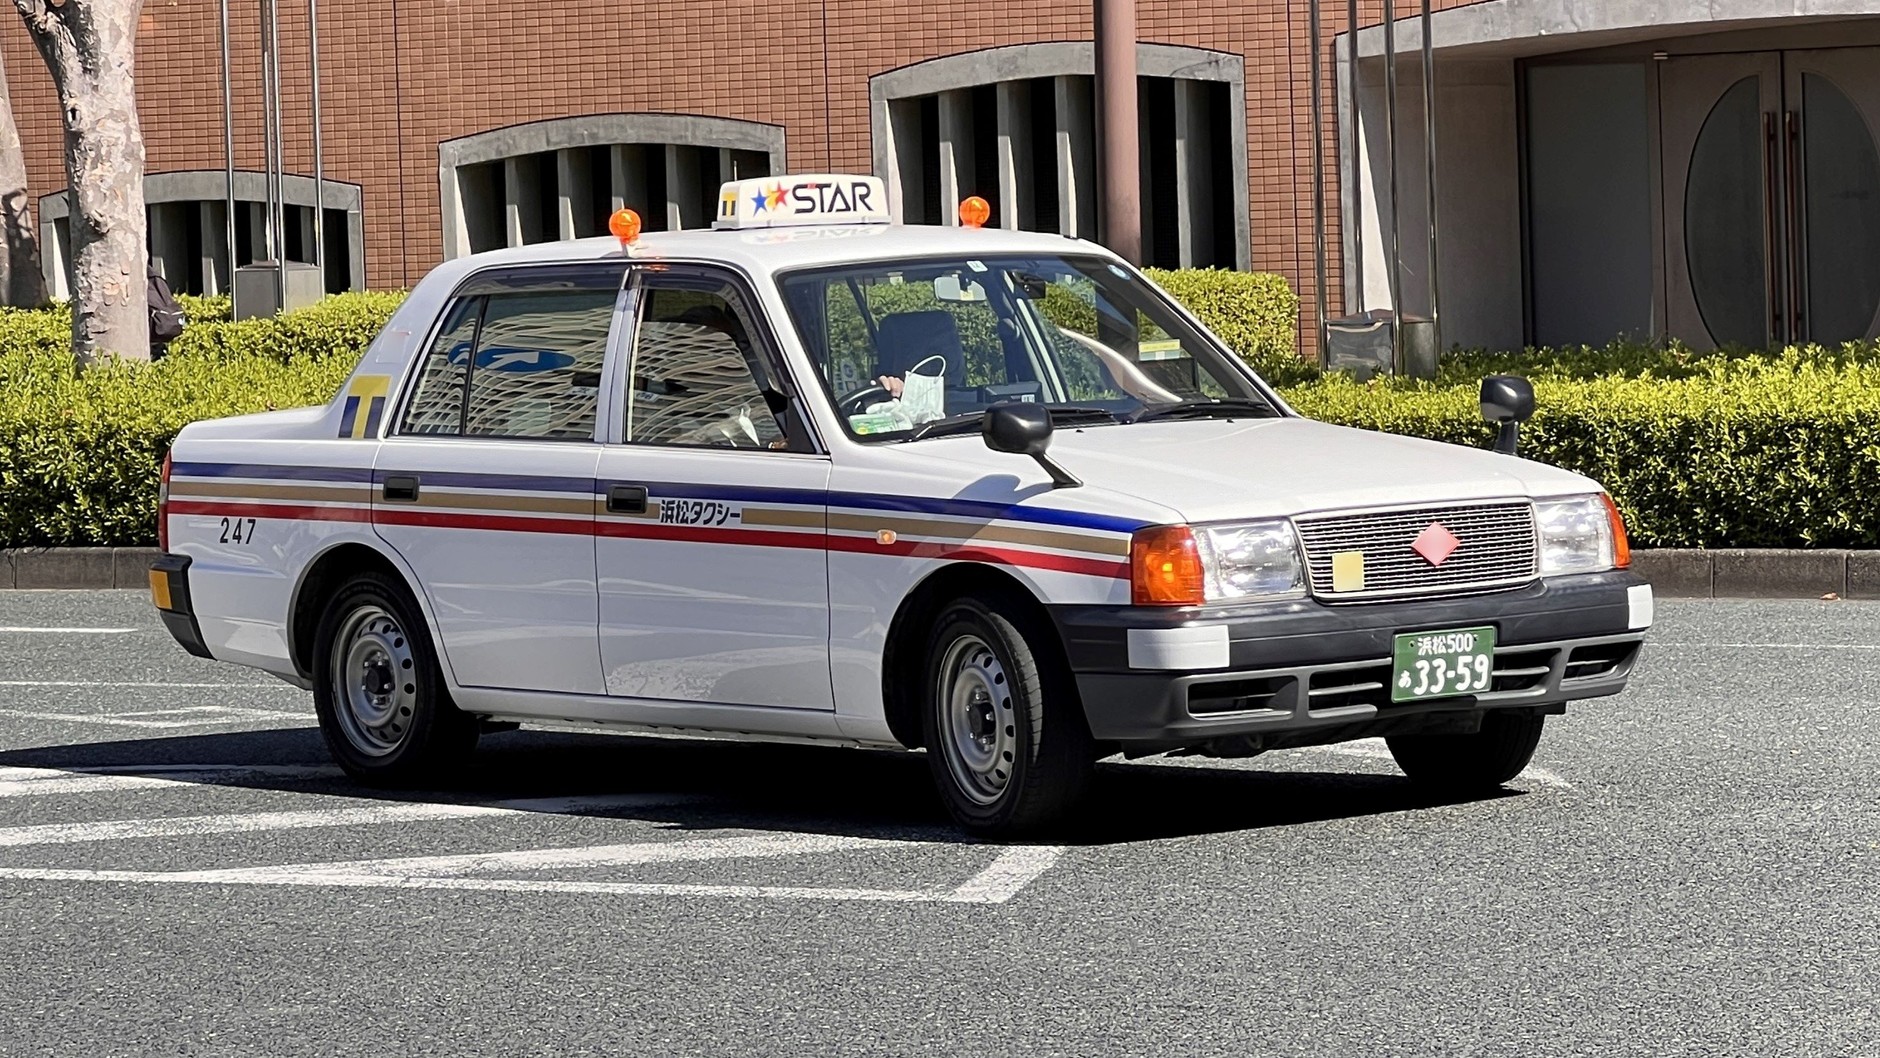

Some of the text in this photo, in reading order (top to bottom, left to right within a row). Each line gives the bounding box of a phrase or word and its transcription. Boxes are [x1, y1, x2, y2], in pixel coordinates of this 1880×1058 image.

[792, 181, 874, 214] STAR
[660, 499, 741, 526] 浜松タクシー
[219, 517, 257, 545] 247
[1398, 653, 1489, 695] あ 33-59
